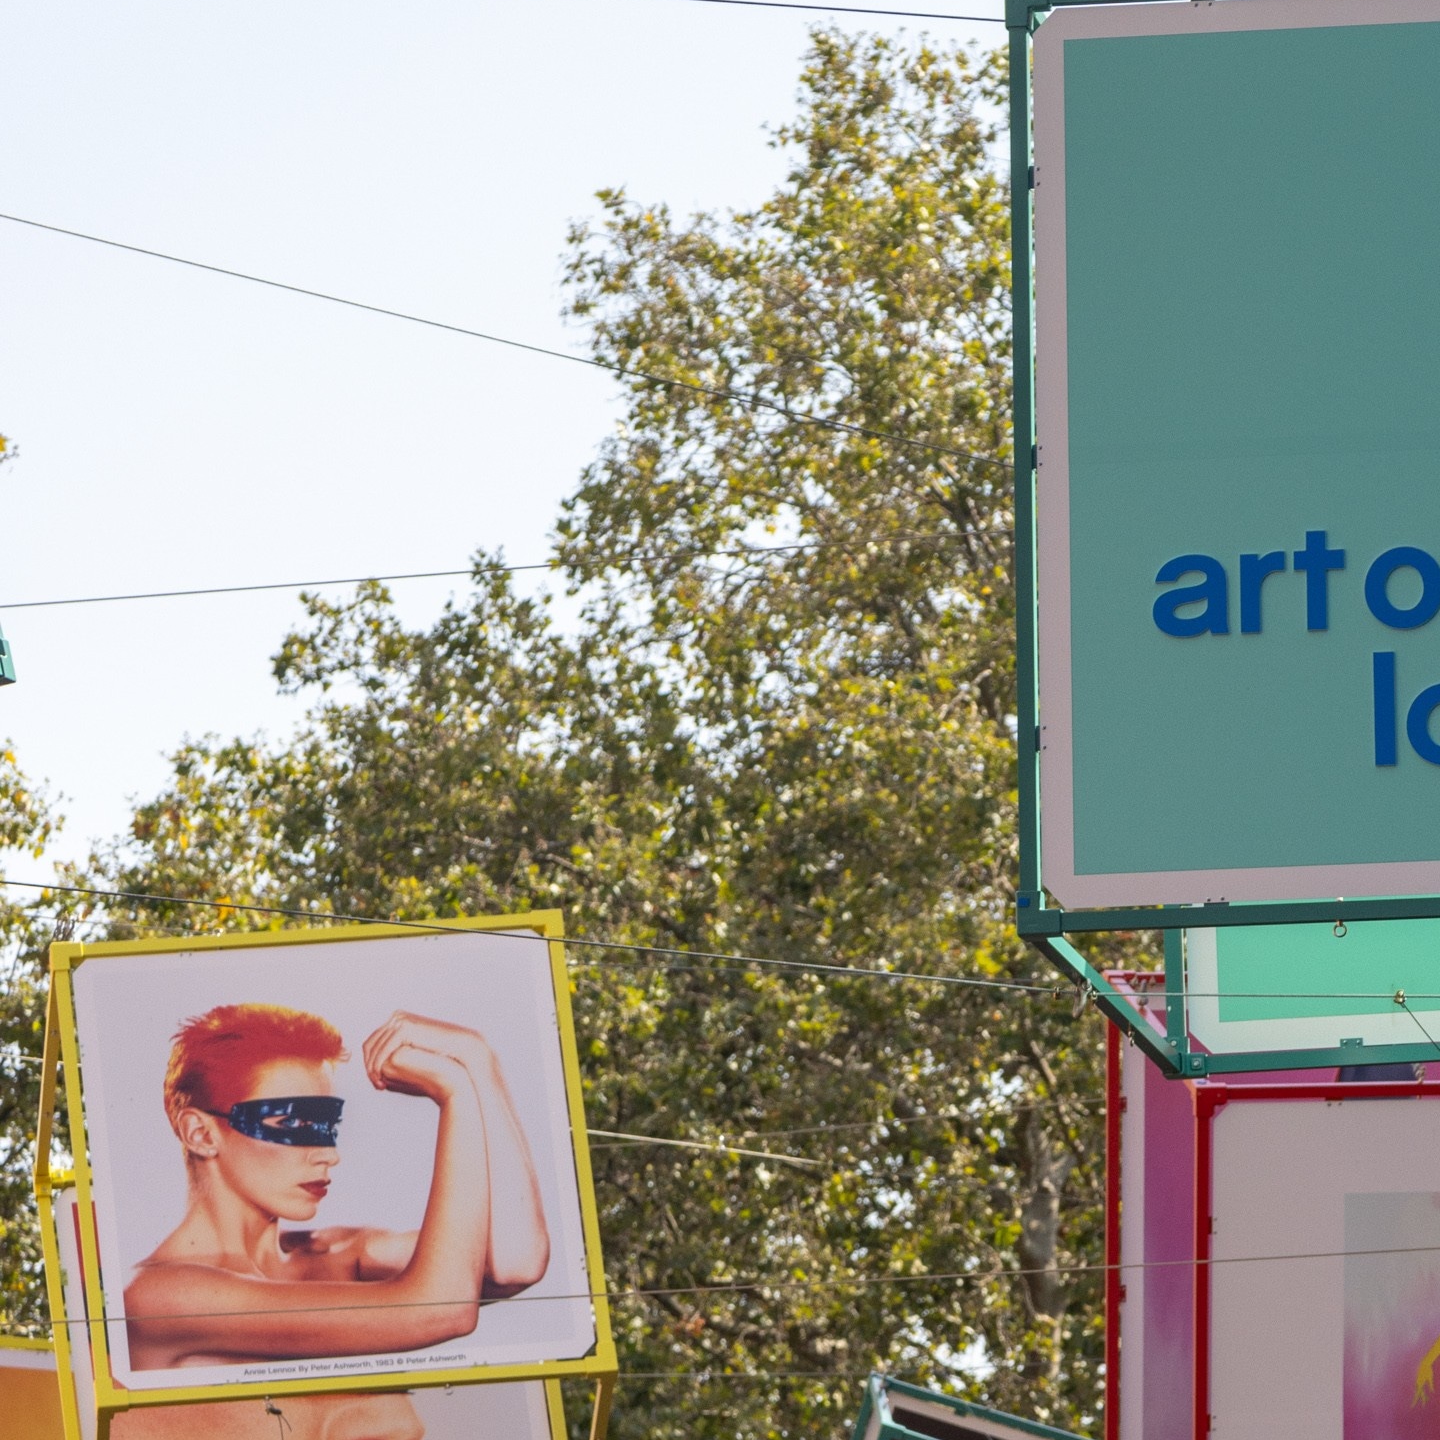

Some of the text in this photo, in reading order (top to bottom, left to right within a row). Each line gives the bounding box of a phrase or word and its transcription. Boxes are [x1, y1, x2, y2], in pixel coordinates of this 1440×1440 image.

[1152, 530, 1346, 639] art
[243, 1367, 267, 1376] Annie
[268, 1366, 296, 1375] Lennox
[298, 1365, 310, 1375] By
[310, 1363, 332, 1372] Peter
[333, 1360, 372, 1370] Ashworth,
[406, 1356, 427, 1364] Peter
[428, 1353, 467, 1363] Ashworth
